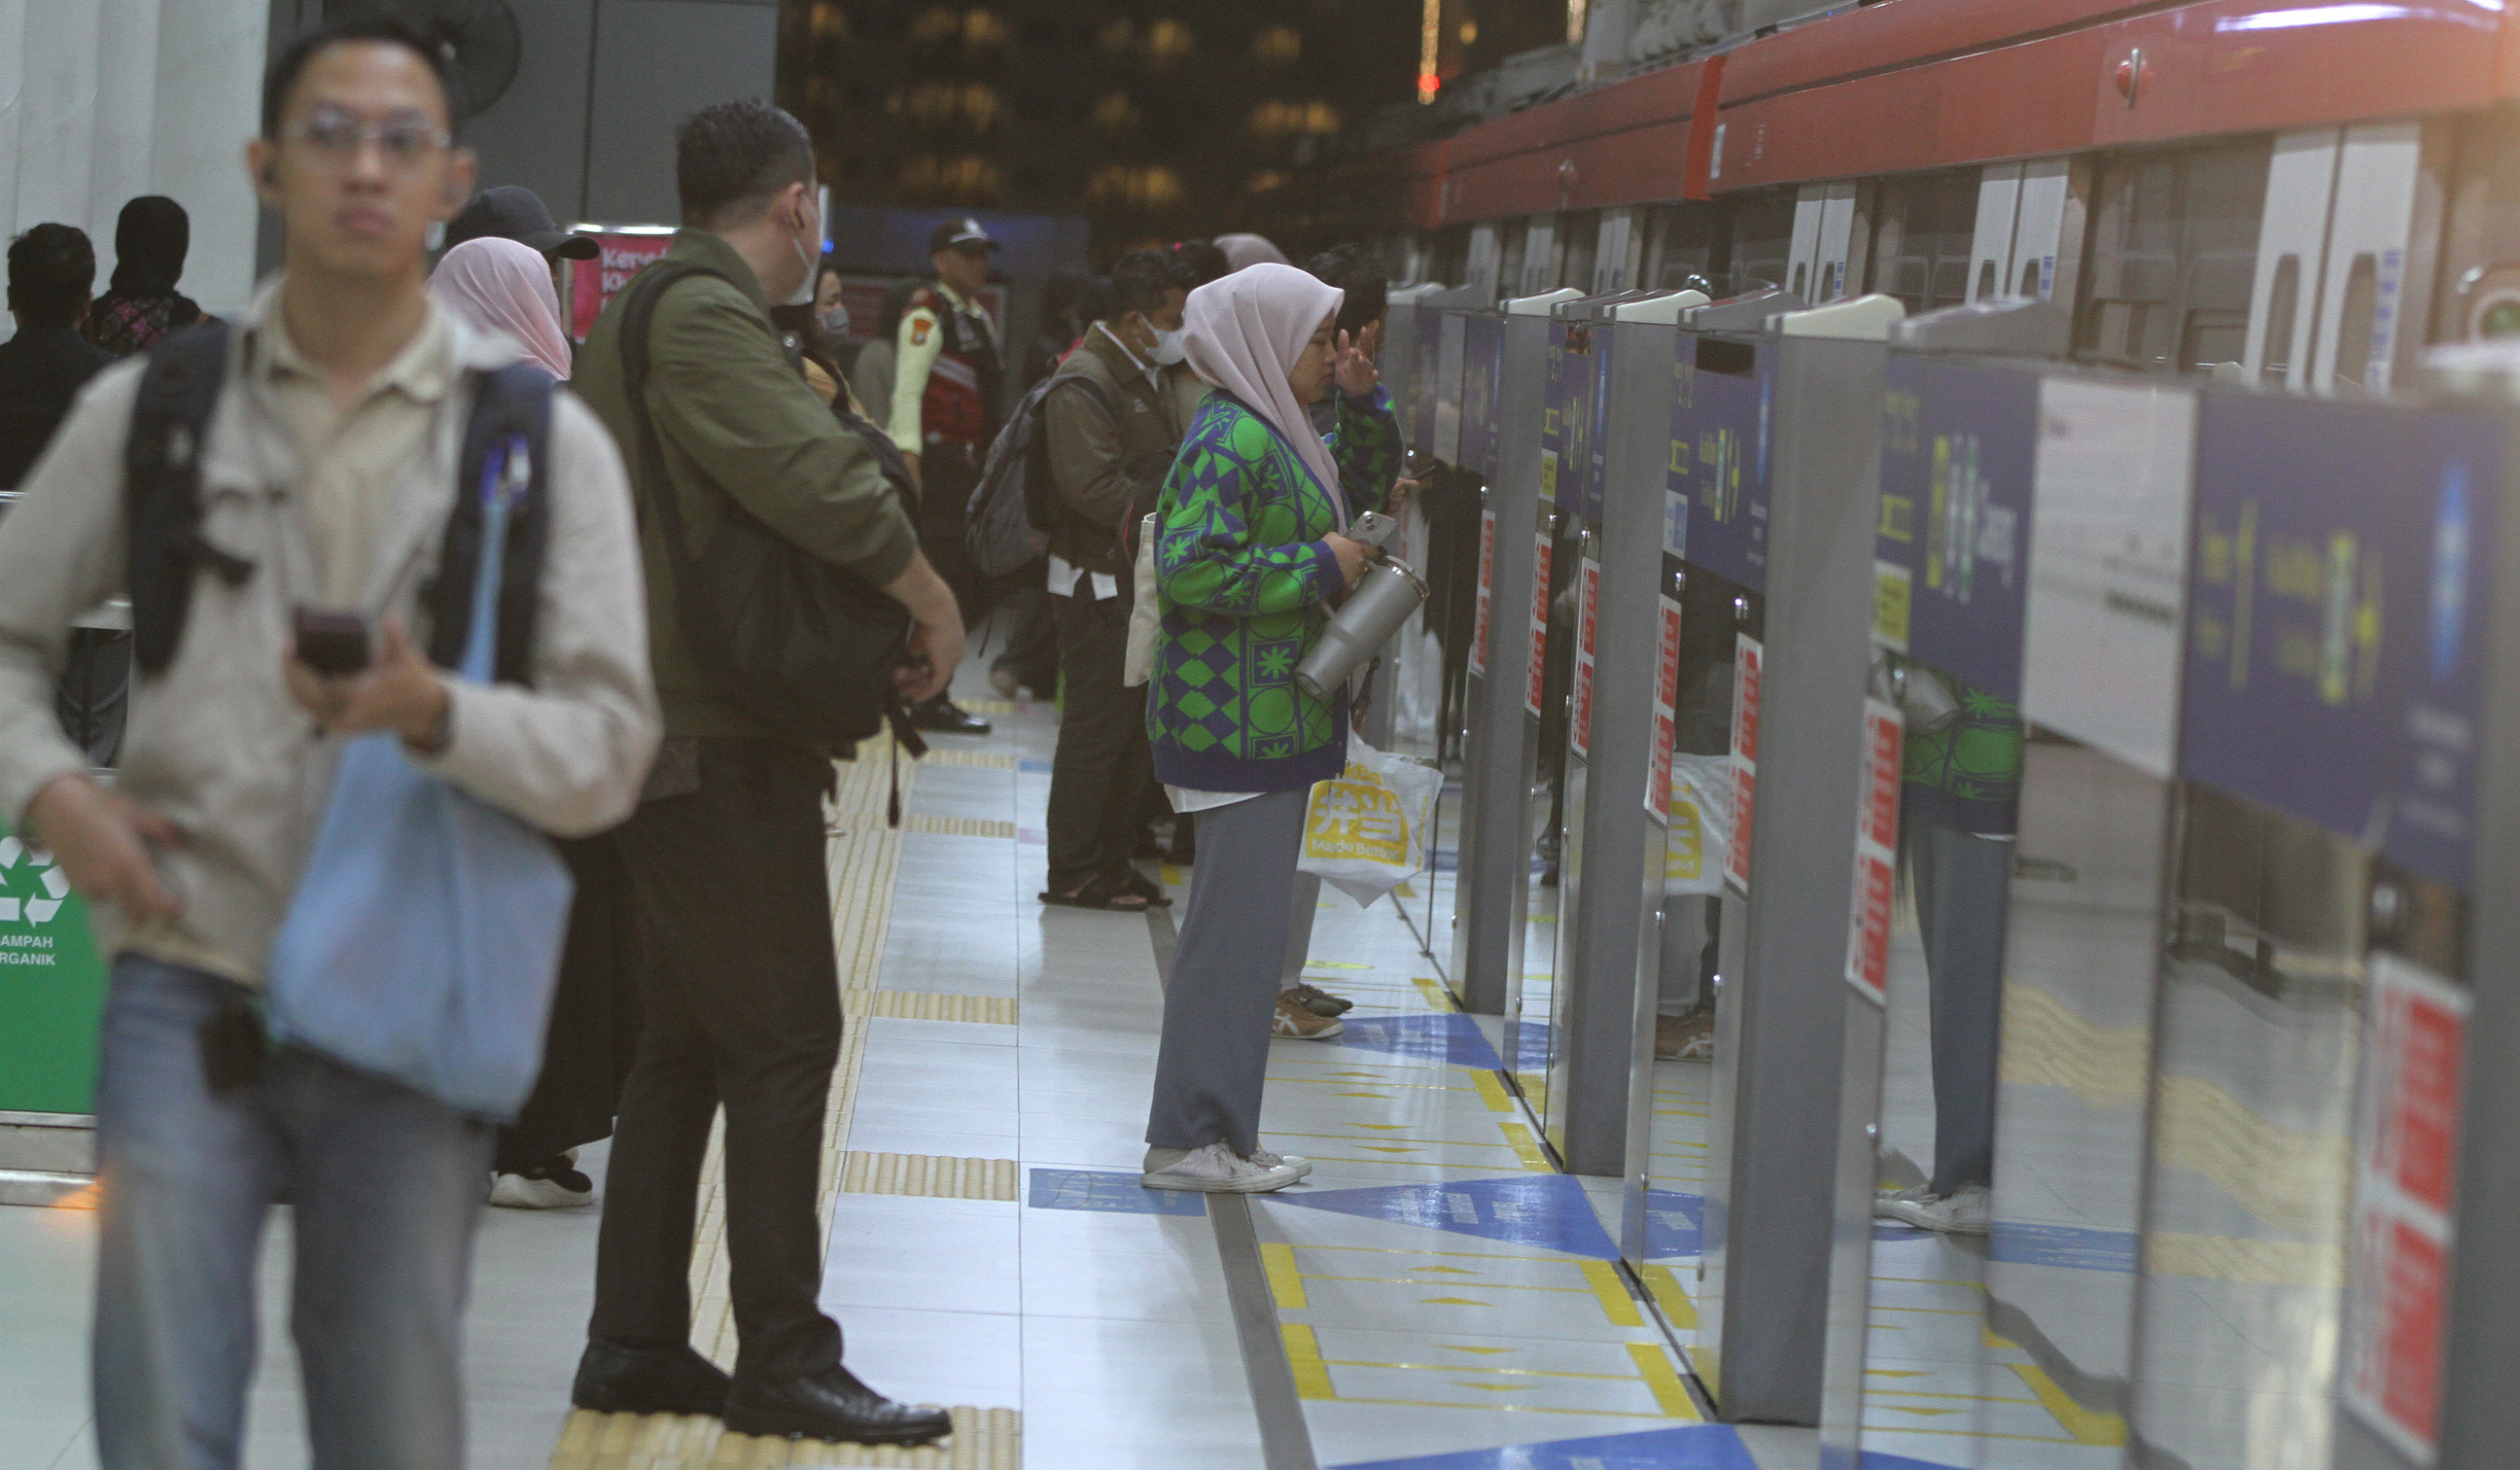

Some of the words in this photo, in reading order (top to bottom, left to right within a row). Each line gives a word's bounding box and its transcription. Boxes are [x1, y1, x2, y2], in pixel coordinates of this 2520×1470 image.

[1313, 788, 1401, 843] 弁当
[1312, 838, 1354, 853] Made
[0, 934, 53, 948] AMPAH
[0, 952, 56, 965] RGANIK
